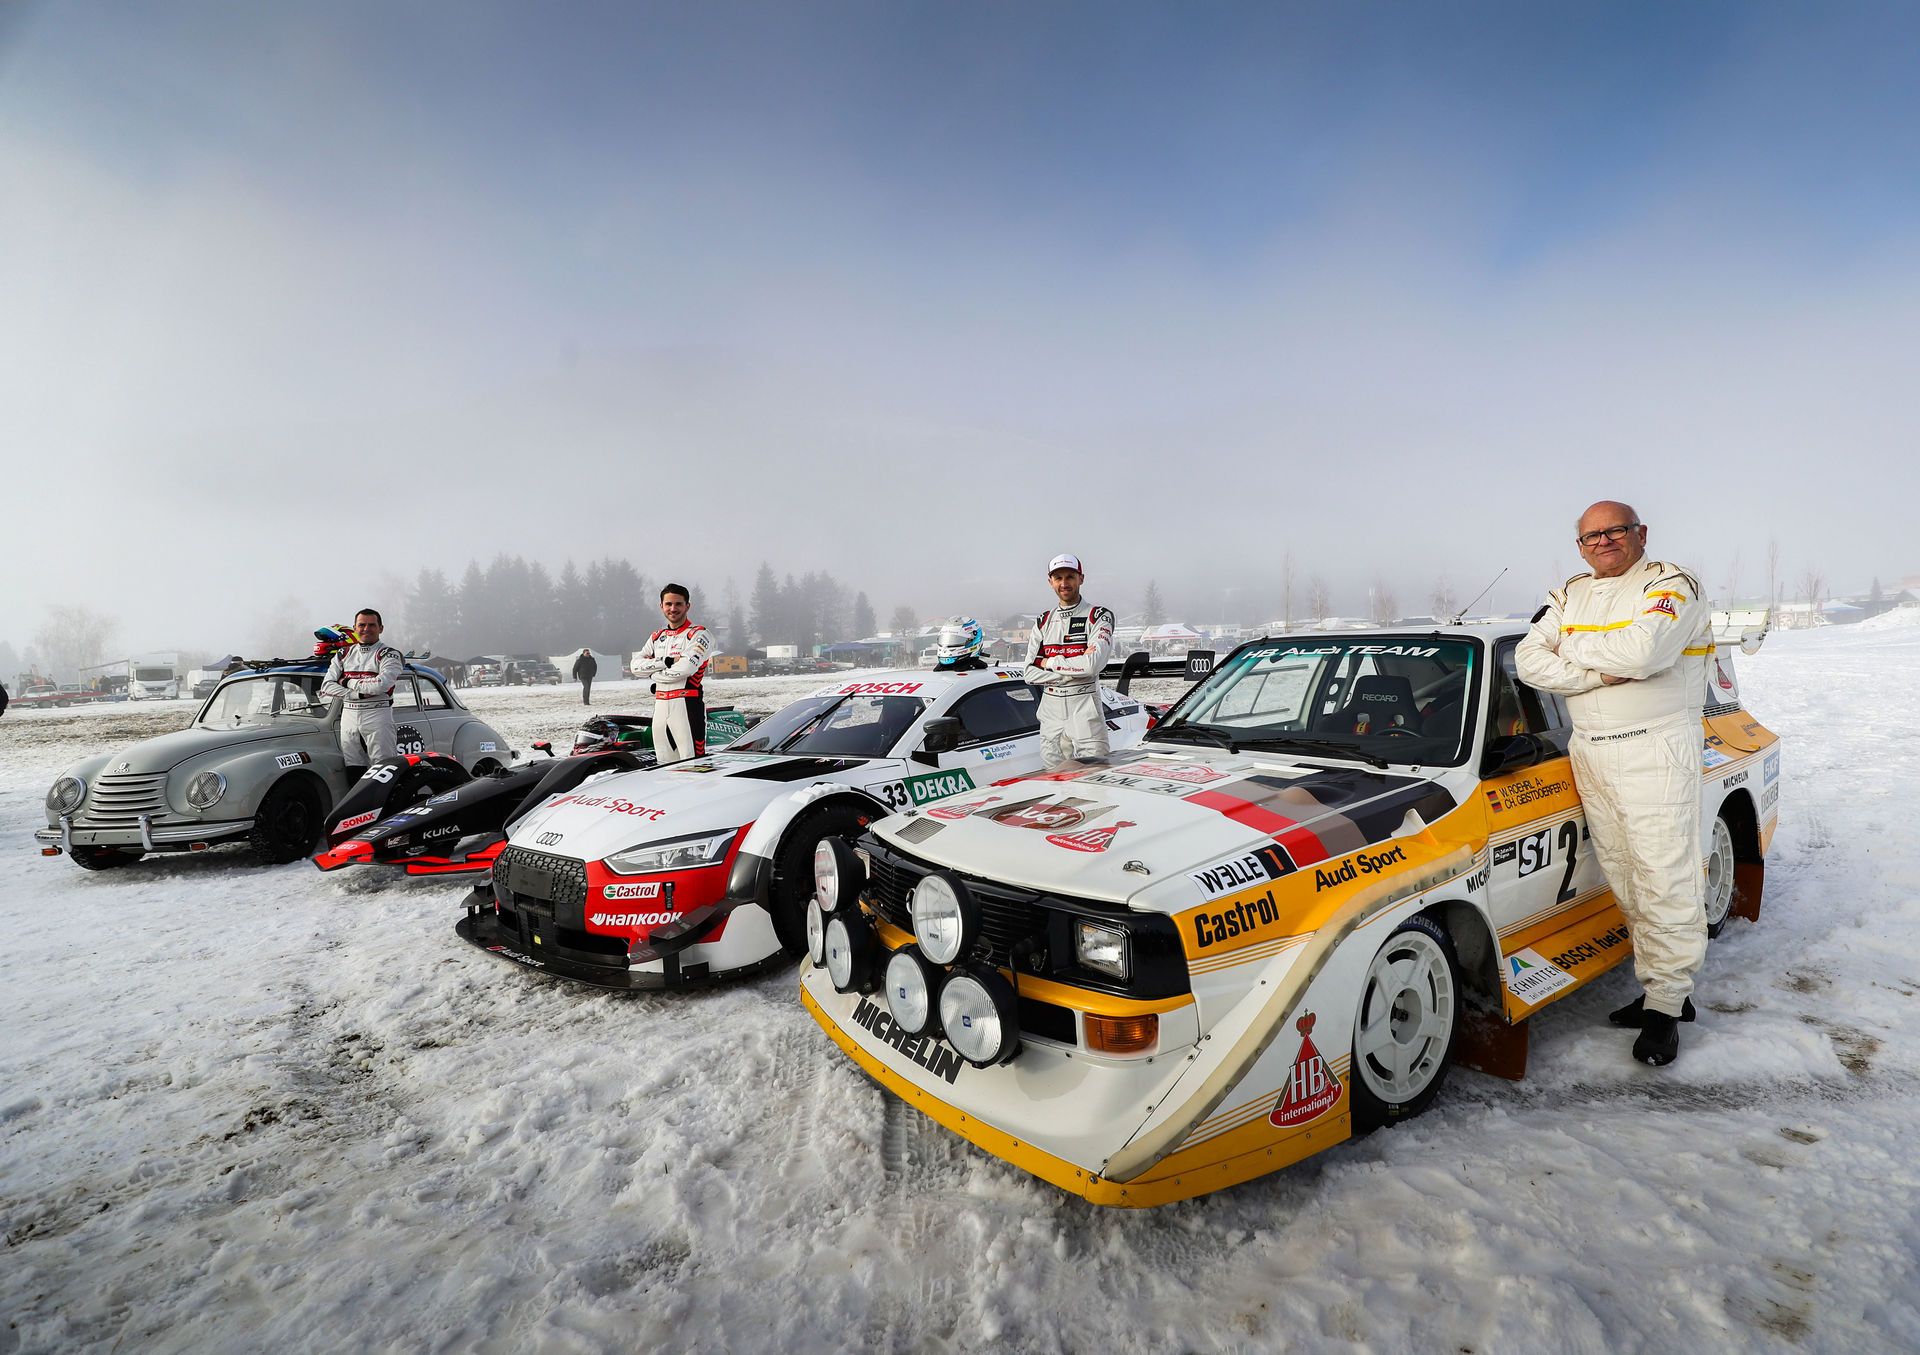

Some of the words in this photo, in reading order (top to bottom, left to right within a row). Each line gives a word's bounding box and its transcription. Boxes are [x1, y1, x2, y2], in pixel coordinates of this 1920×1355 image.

[1242, 648, 1279, 660] HB
[1348, 645, 1440, 658] TEAM
[837, 683, 924, 694] BOSCH
[1362, 694, 1398, 702] RECARO
[1608, 729, 1647, 741] TRADITION
[396, 741, 423, 757] S19
[361, 765, 398, 783] 66
[913, 773, 971, 800] DEKRA
[1723, 770, 1749, 789] MICHELIN
[572, 795, 612, 806] Audi
[603, 798, 665, 820] Sport
[883, 783, 908, 808] 33
[343, 813, 375, 828] SONAX
[423, 825, 461, 839] KUKA
[1264, 849, 1285, 871] 1
[1520, 830, 1550, 875] S1
[1556, 820, 1578, 904] 2
[1315, 858, 1358, 892] Audi
[1356, 845, 1407, 874] Sport
[616, 885, 656, 897] Castrol
[1194, 890, 1279, 948] Castrol
[1551, 942, 1601, 970] BOSCH
[1592, 928, 1619, 949] fuel
[1508, 965, 1563, 995] SCHMITTEN
[852, 997, 964, 1085] MICHELIN
[1289, 1055, 1326, 1104] HB
[1281, 1091, 1334, 1122] international
